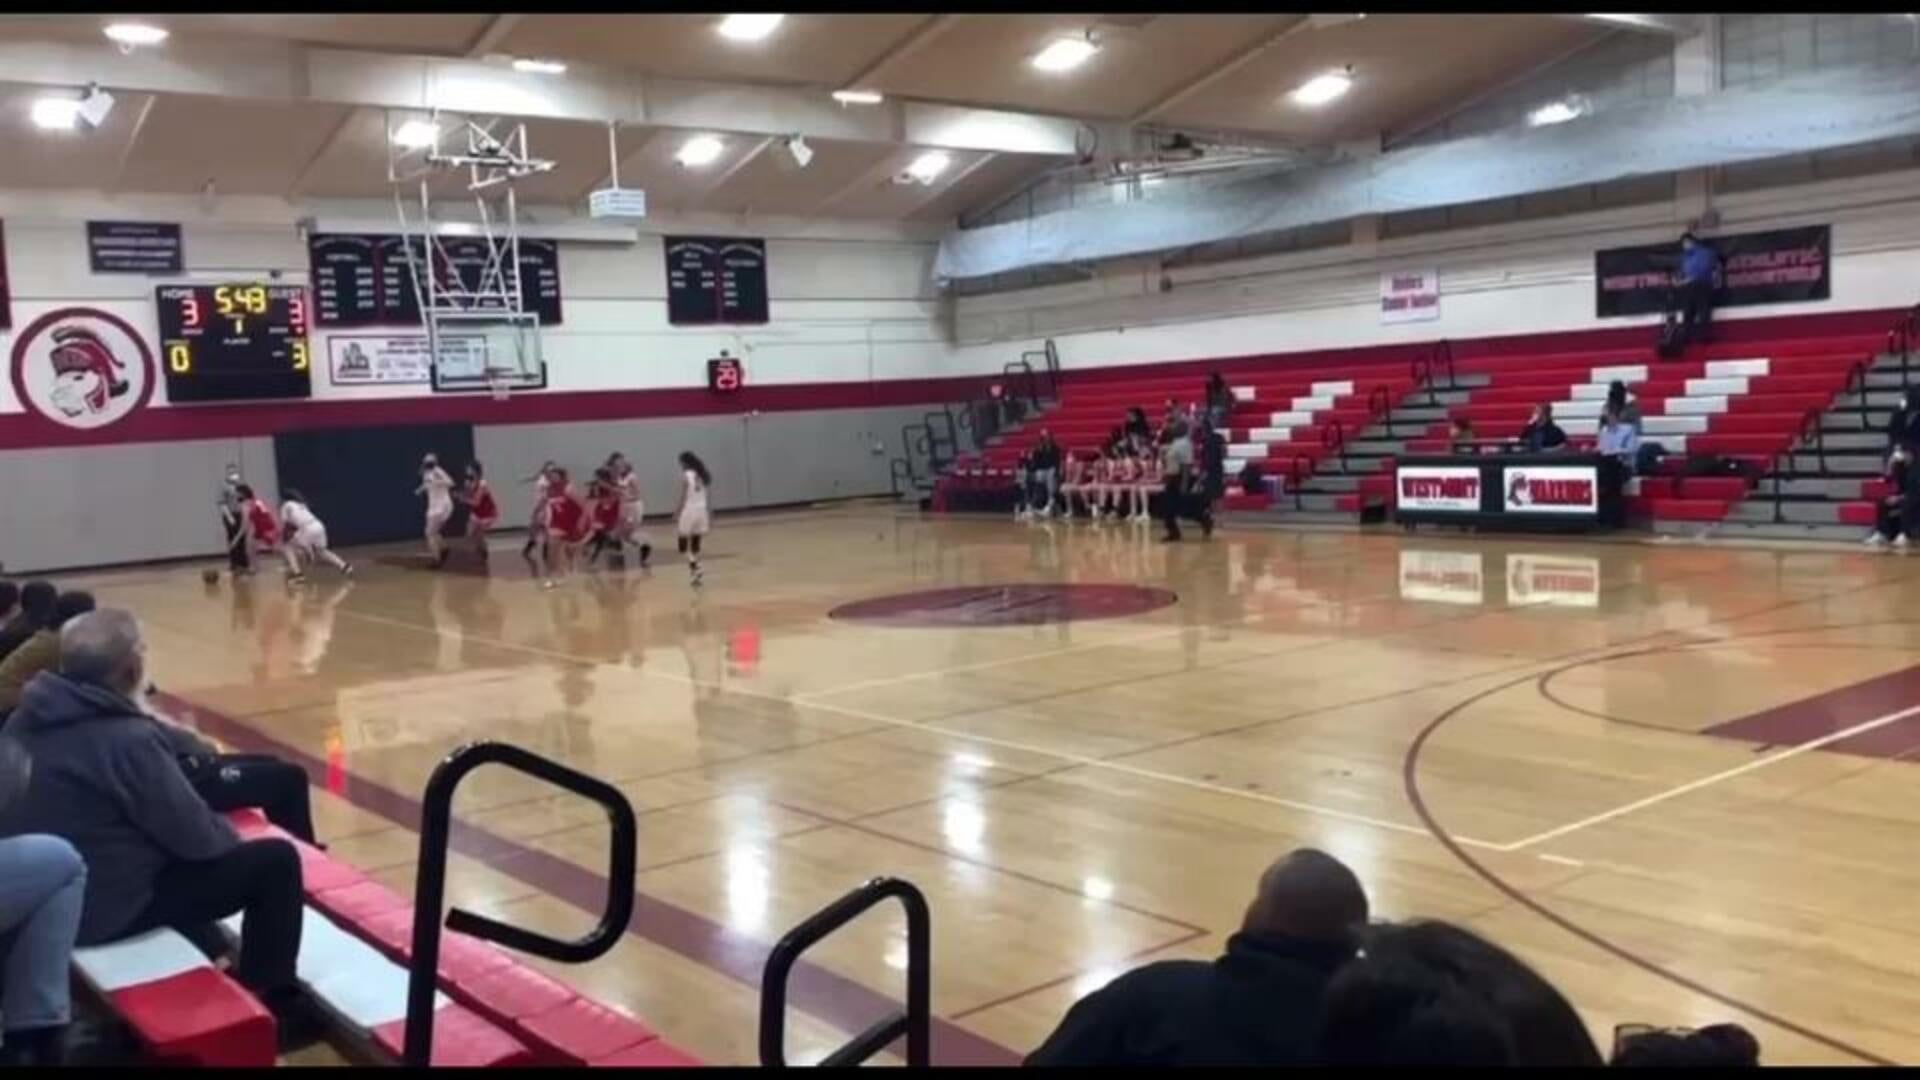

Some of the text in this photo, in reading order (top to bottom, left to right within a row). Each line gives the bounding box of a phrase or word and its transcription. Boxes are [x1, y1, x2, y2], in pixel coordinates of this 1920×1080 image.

[182, 299, 199, 326] 3
[288, 299, 303, 324] 3
[170, 345, 190, 372] 0
[293, 343, 307, 369] 3
